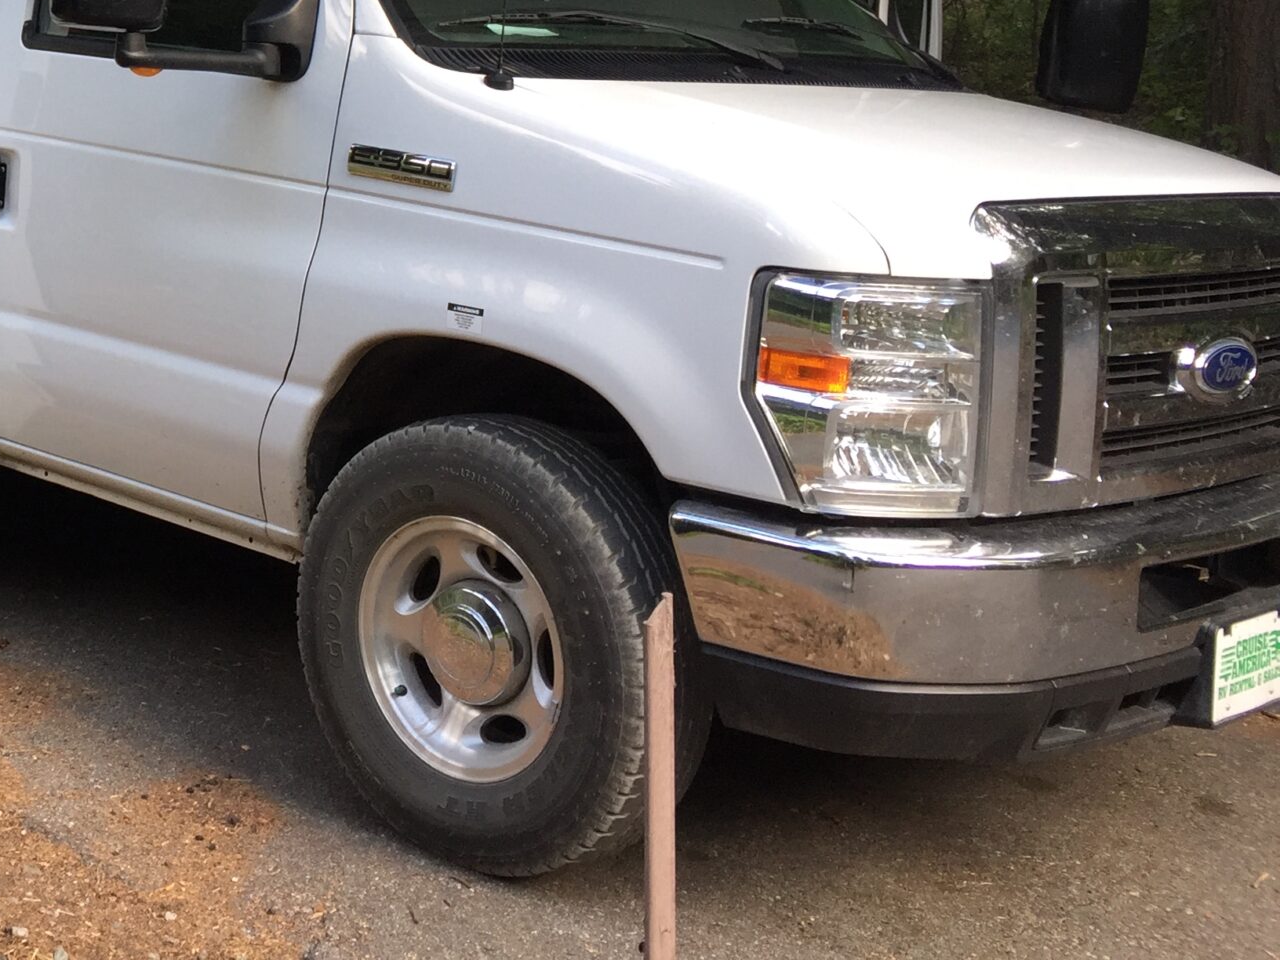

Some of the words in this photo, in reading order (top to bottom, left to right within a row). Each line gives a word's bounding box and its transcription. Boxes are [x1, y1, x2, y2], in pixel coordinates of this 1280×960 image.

[391, 173, 421, 187] SUPER
[422, 178, 450, 190] DUTY
[1215, 351, 1249, 383] Ford
[1236, 632, 1269, 659] CRUISE
[1231, 649, 1271, 680] AMERICA
[1218, 685, 1228, 701] RV
[1229, 675, 1256, 697] RENTAL
